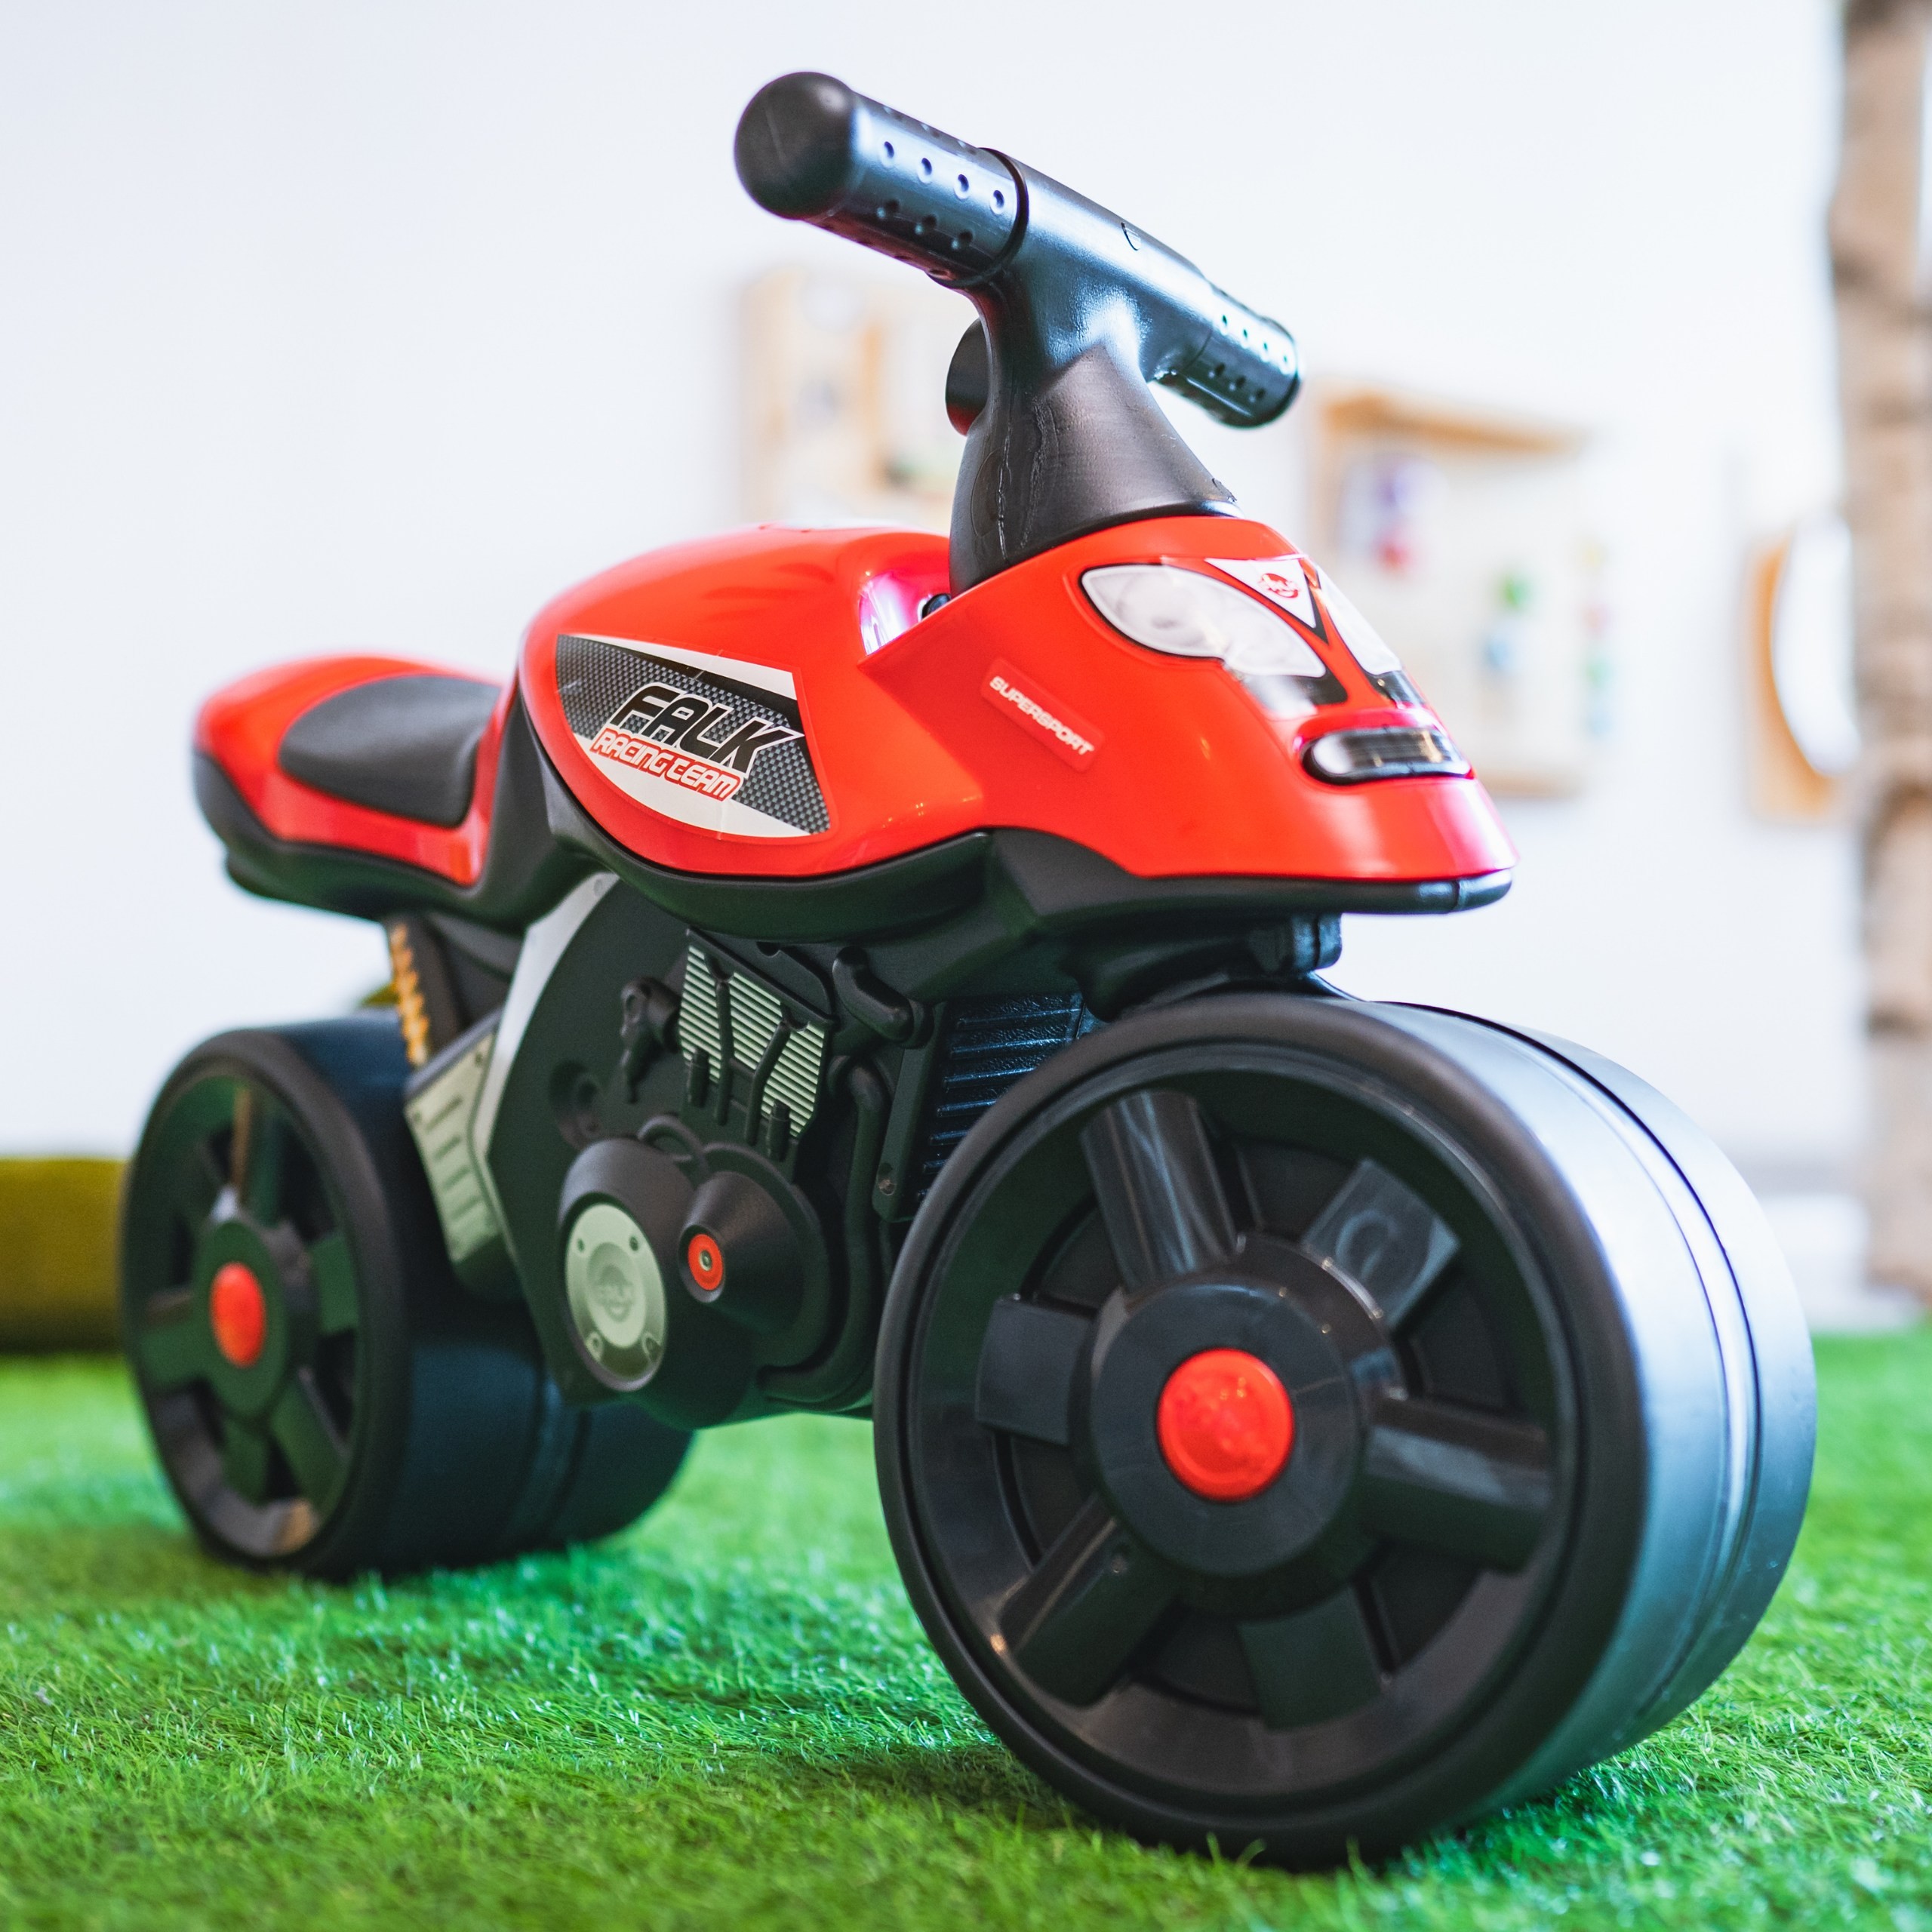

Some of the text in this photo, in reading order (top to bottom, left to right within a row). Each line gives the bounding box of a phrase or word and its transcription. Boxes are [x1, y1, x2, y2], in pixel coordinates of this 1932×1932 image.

[591, 729, 675, 777] RACING
[606, 682, 803, 777] FALK
[989, 675, 1095, 755] SUPERSPORT
